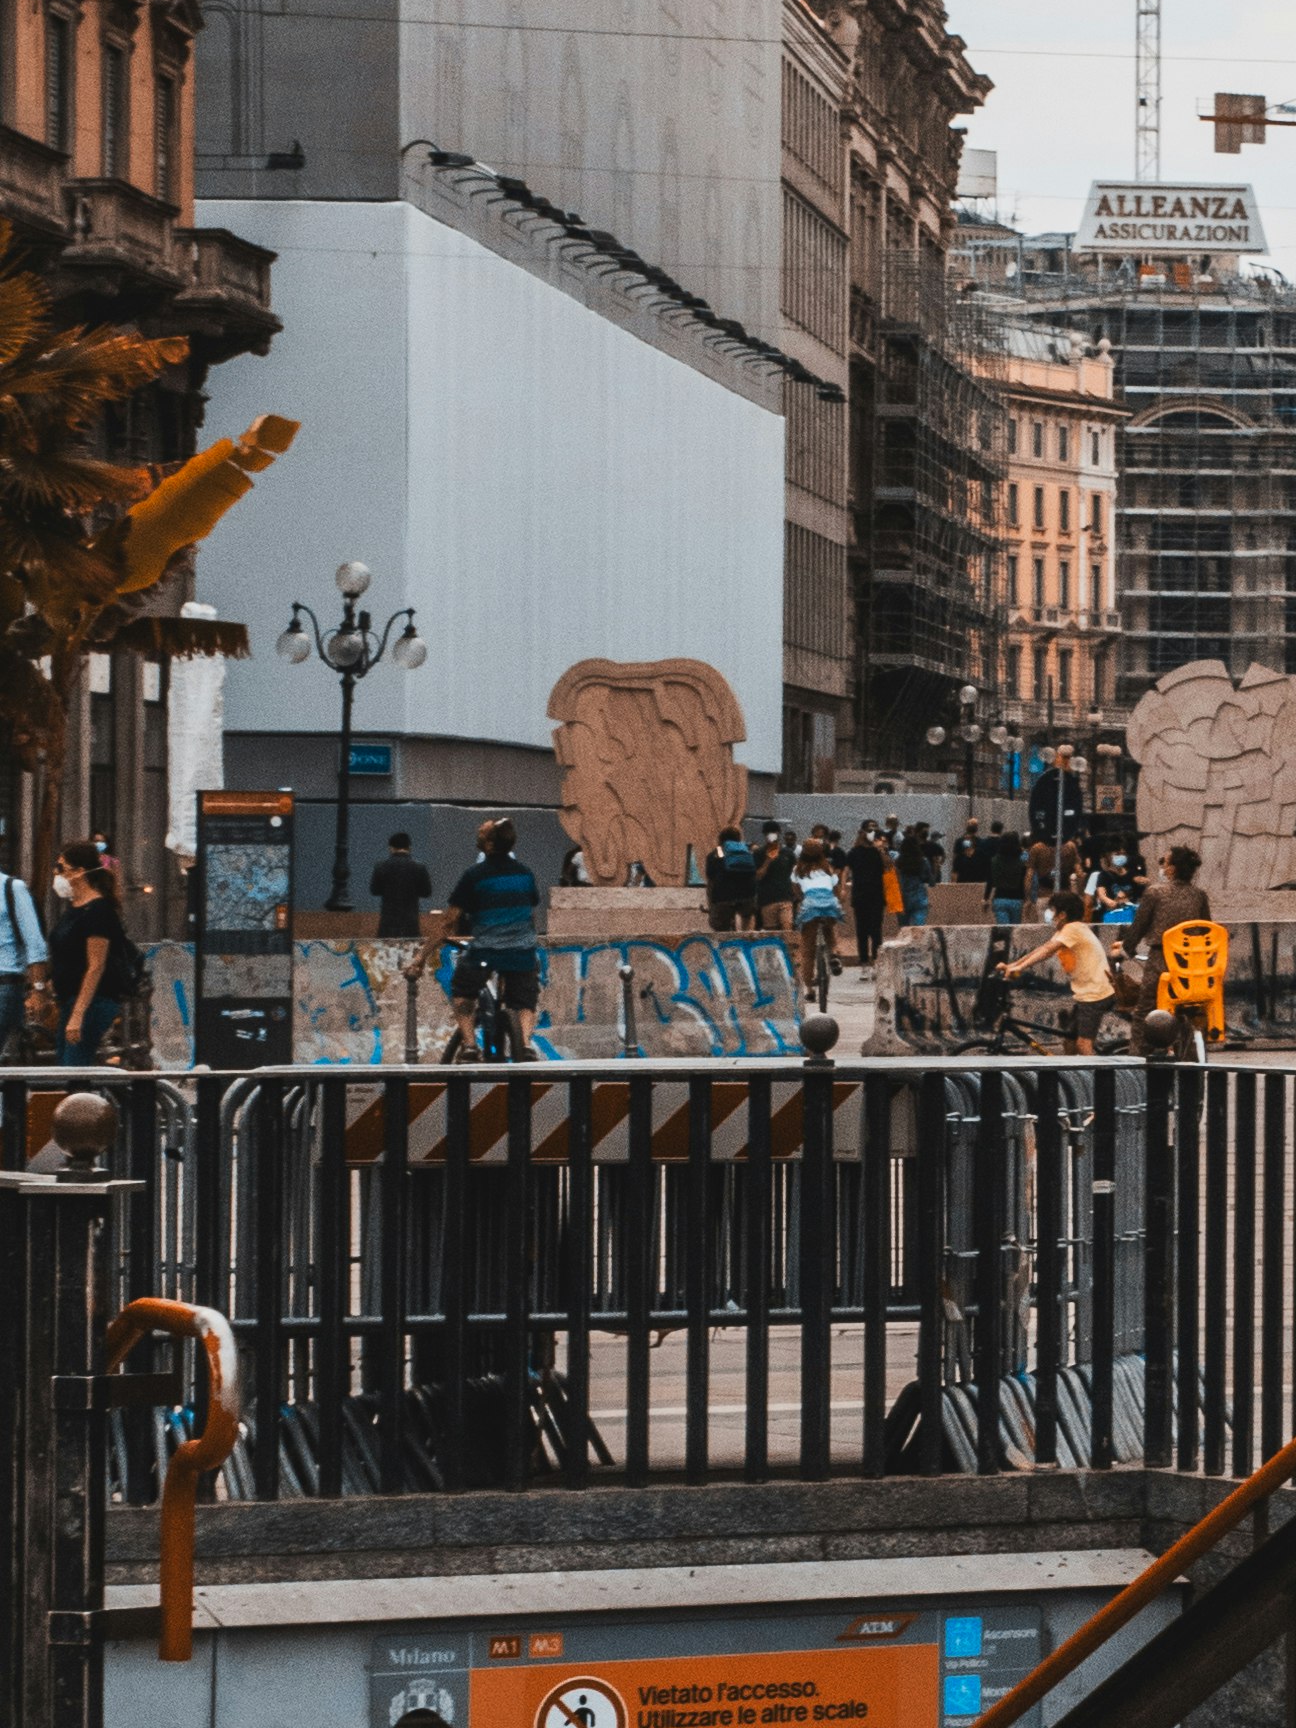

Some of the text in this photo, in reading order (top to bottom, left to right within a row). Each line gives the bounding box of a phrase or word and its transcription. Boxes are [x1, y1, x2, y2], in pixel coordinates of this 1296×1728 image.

[1094, 194, 1249, 220] ALLEANZA
[1094, 223, 1249, 242] ASSICURAZIONI
[860, 1621, 894, 1634] ATM
[491, 1637, 560, 1655] M1 M3
[388, 1647, 456, 1666] Milano
[638, 1680, 820, 1706] Vietato l'accesso.
[737, 1706, 755, 1724] le
[761, 1703, 808, 1724] altre
[813, 1699, 868, 1721] scale
